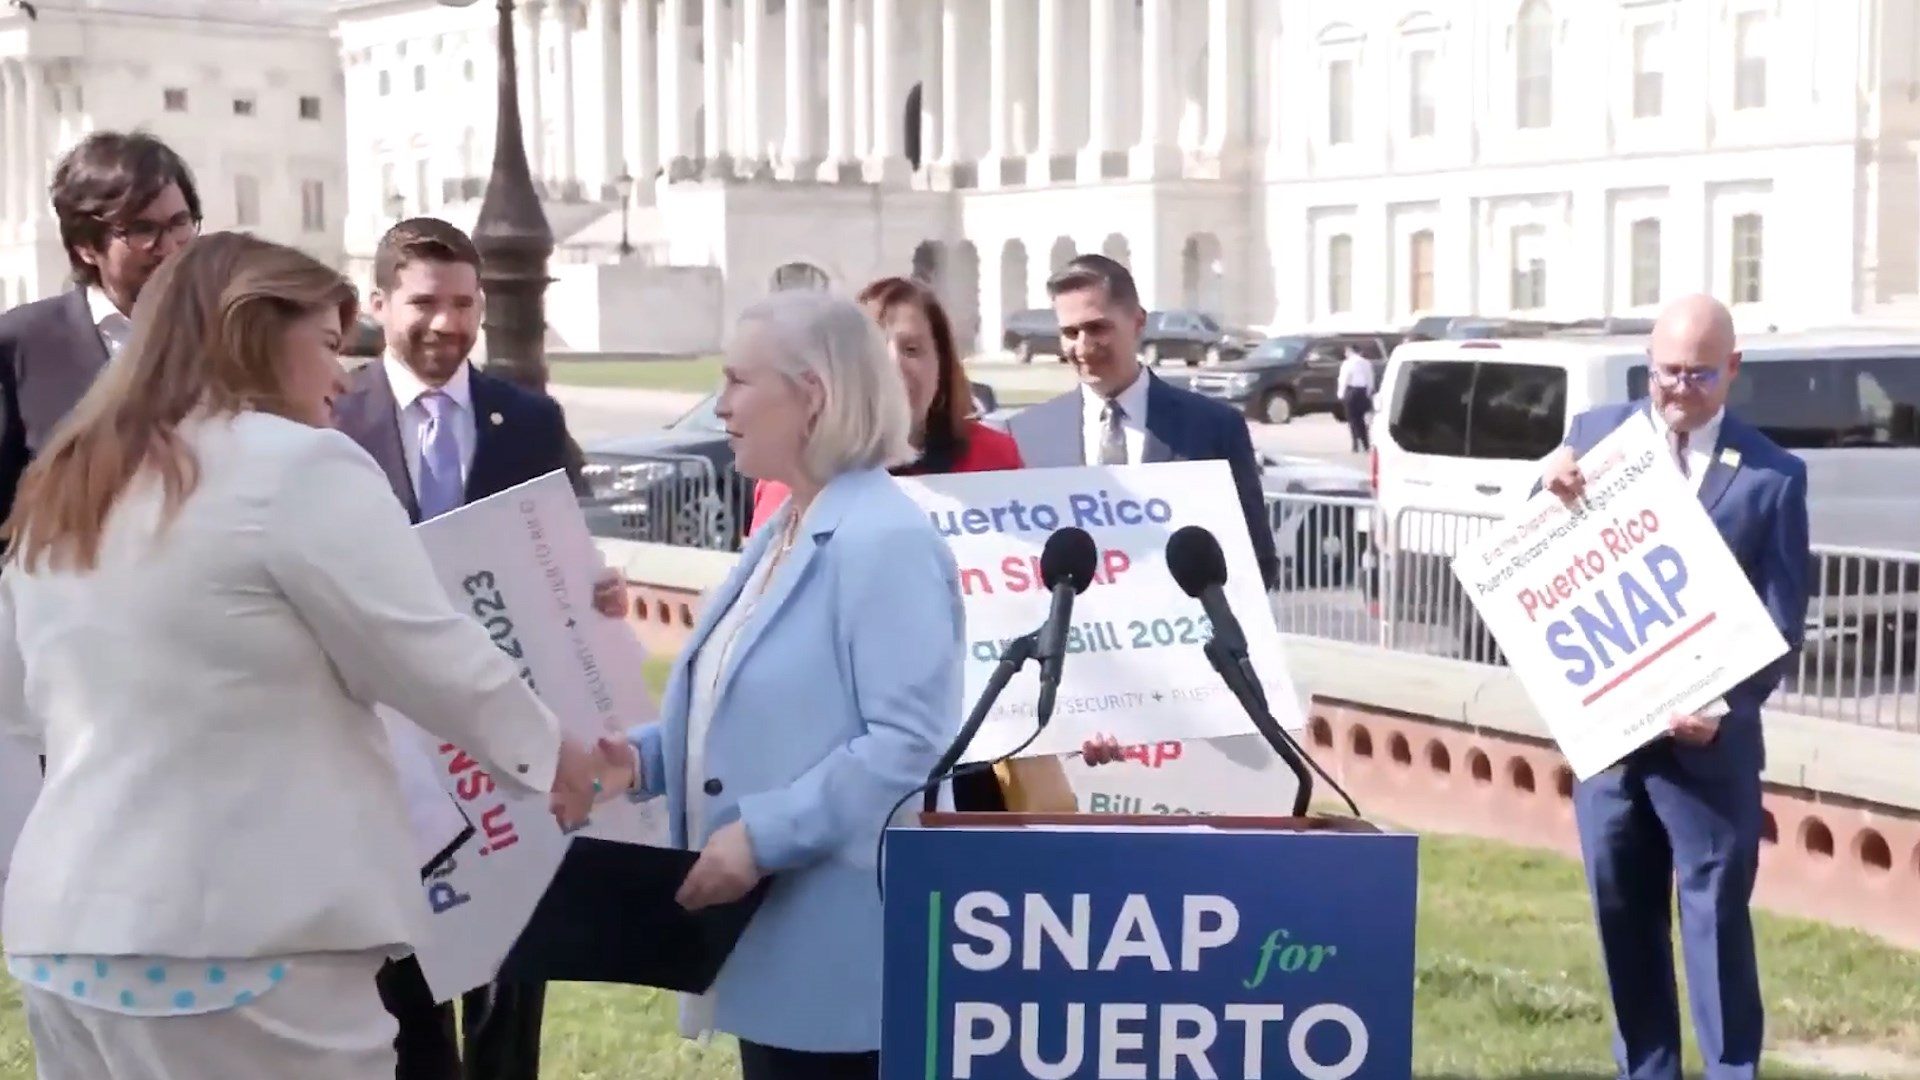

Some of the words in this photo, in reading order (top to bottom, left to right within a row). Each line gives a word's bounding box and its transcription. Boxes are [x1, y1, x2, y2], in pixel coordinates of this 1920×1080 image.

[930, 499, 1060, 536] uerto
[1069, 490, 1172, 528] Rico
[959, 567, 994, 596] n
[1517, 549, 1605, 622] Puerto
[1599, 508, 1660, 562] Rico
[1545, 544, 1689, 687] SNAP
[1065, 691, 1145, 715] SECURITY
[478, 803, 519, 857] in
[951, 890, 1240, 973] SNAP
[1242, 928, 1338, 989] for
[951, 1001, 1370, 1080] PUERTO
